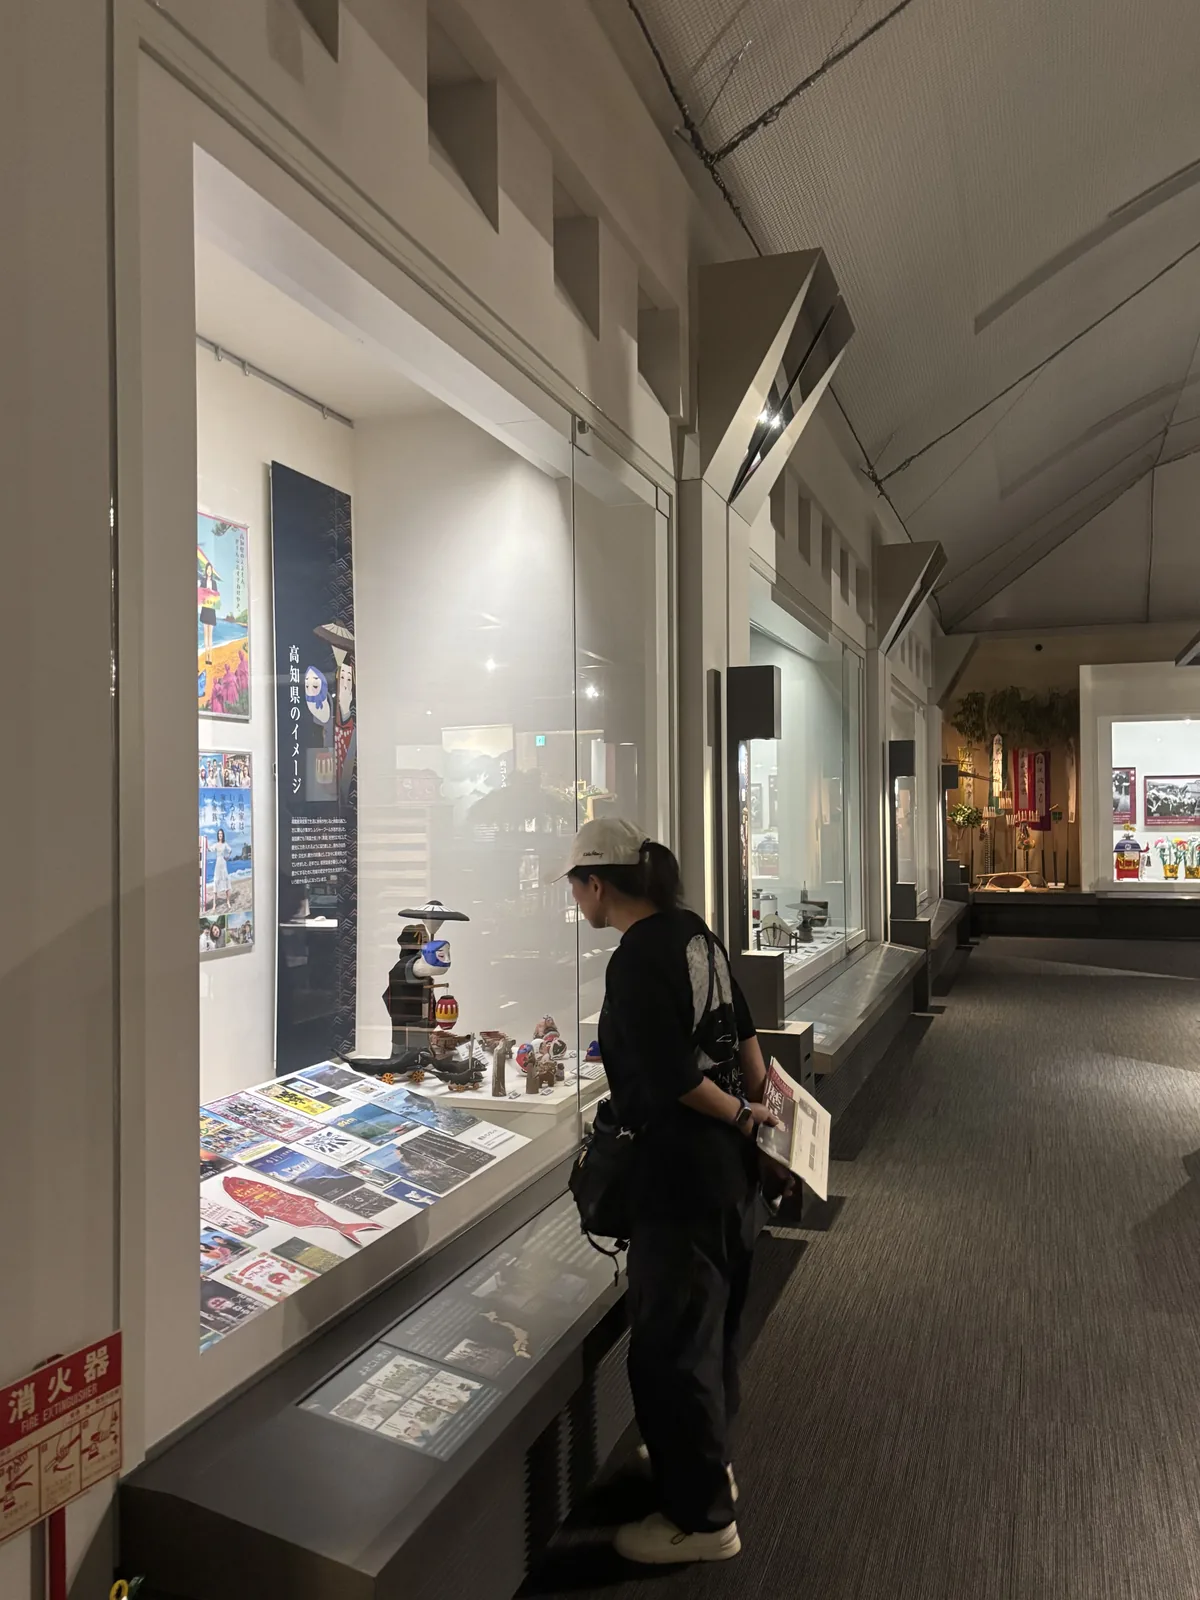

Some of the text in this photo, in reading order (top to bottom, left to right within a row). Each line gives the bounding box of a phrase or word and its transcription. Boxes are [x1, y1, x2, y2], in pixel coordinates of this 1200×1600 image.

[288, 644, 301, 794] 高知県のイメージ
[8, 1345, 110, 1424] 消火器
[21, 1413, 40, 1434] FIRE
[43, 1382, 98, 1421] EXTINGUISHER
